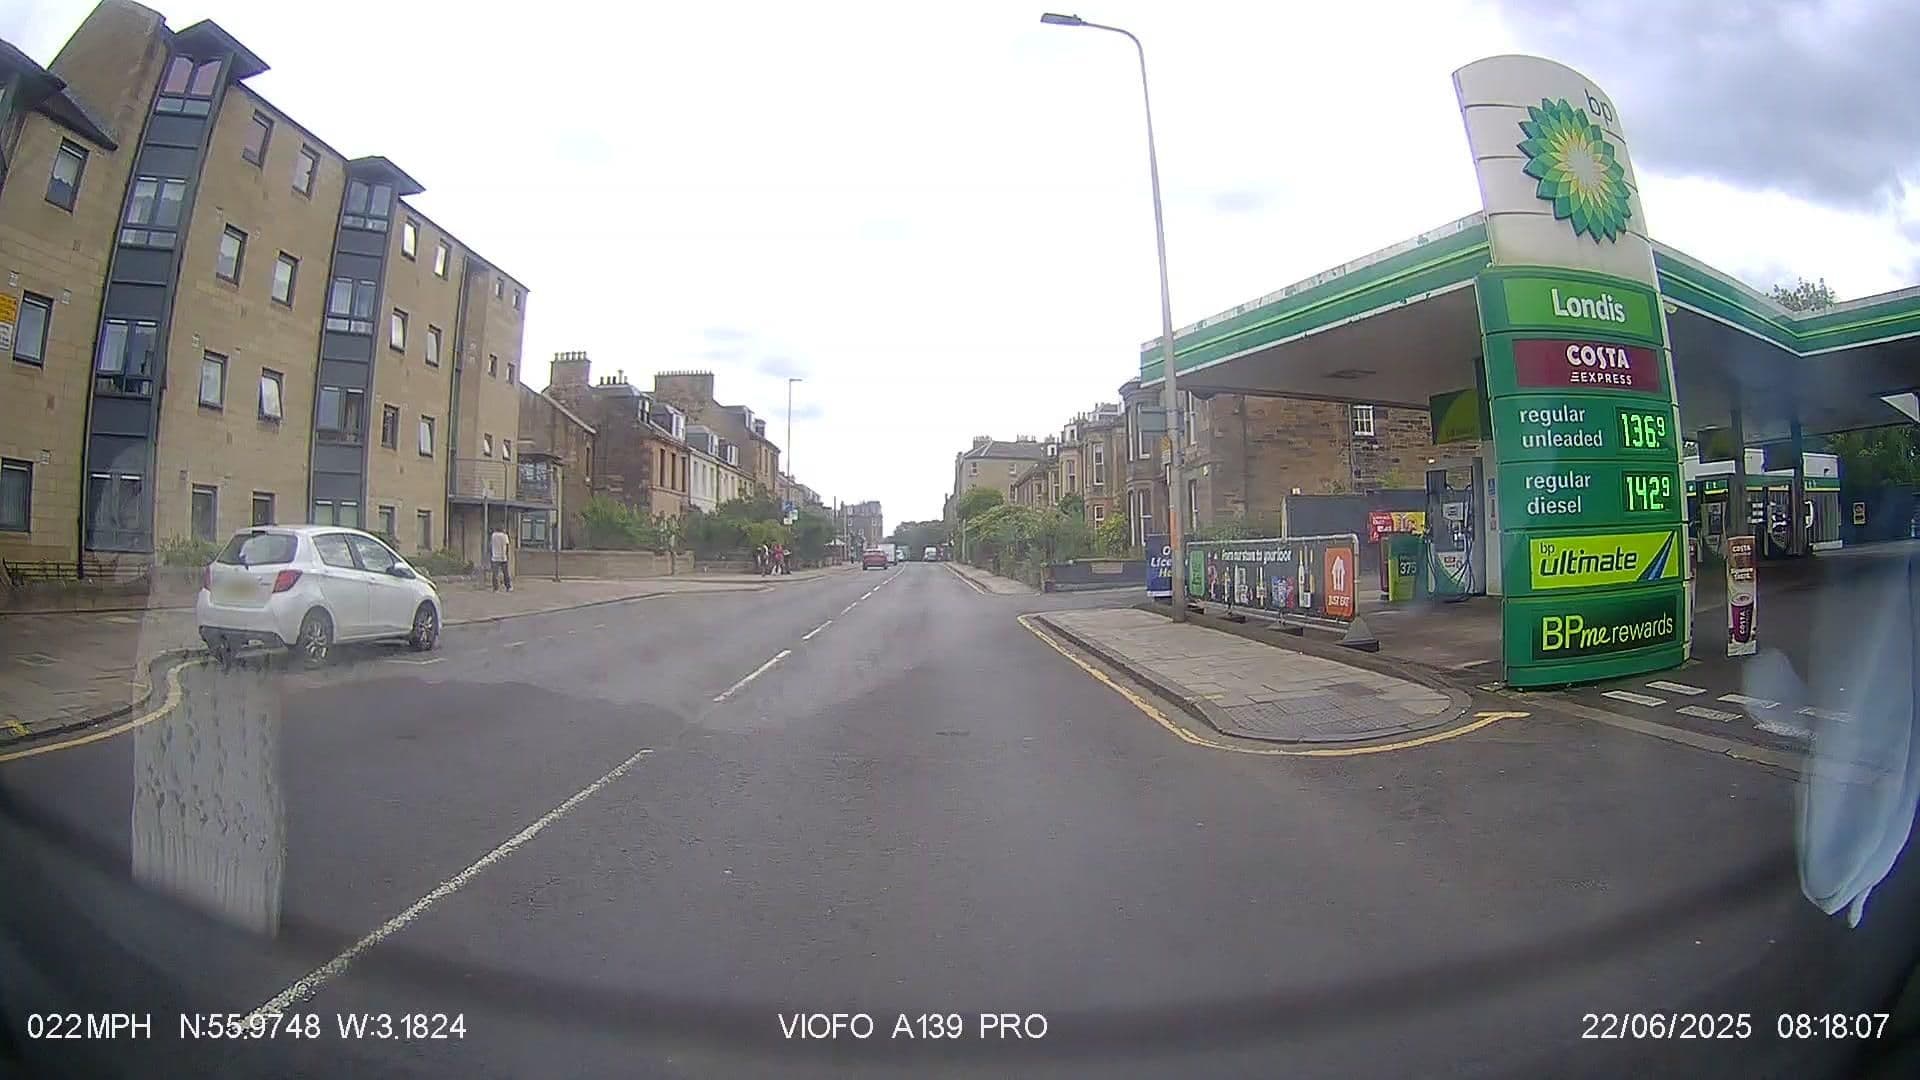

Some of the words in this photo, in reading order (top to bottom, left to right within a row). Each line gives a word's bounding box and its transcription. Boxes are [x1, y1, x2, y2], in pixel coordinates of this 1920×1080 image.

[1585, 88, 1612, 127] bp
[1551, 288, 1625, 322] Londis
[1566, 344, 1630, 370] COSTA
[1580, 372, 1632, 385] EXPRESS
[1520, 404, 1586, 426] regular
[1522, 430, 1603, 448] unleaded
[1525, 470, 1591, 493] regular
[1527, 495, 1582, 514] diesel
[1540, 542, 1555, 556] bp
[1540, 546, 1638, 577] ultimate
[1612, 611, 1673, 644] rewards
